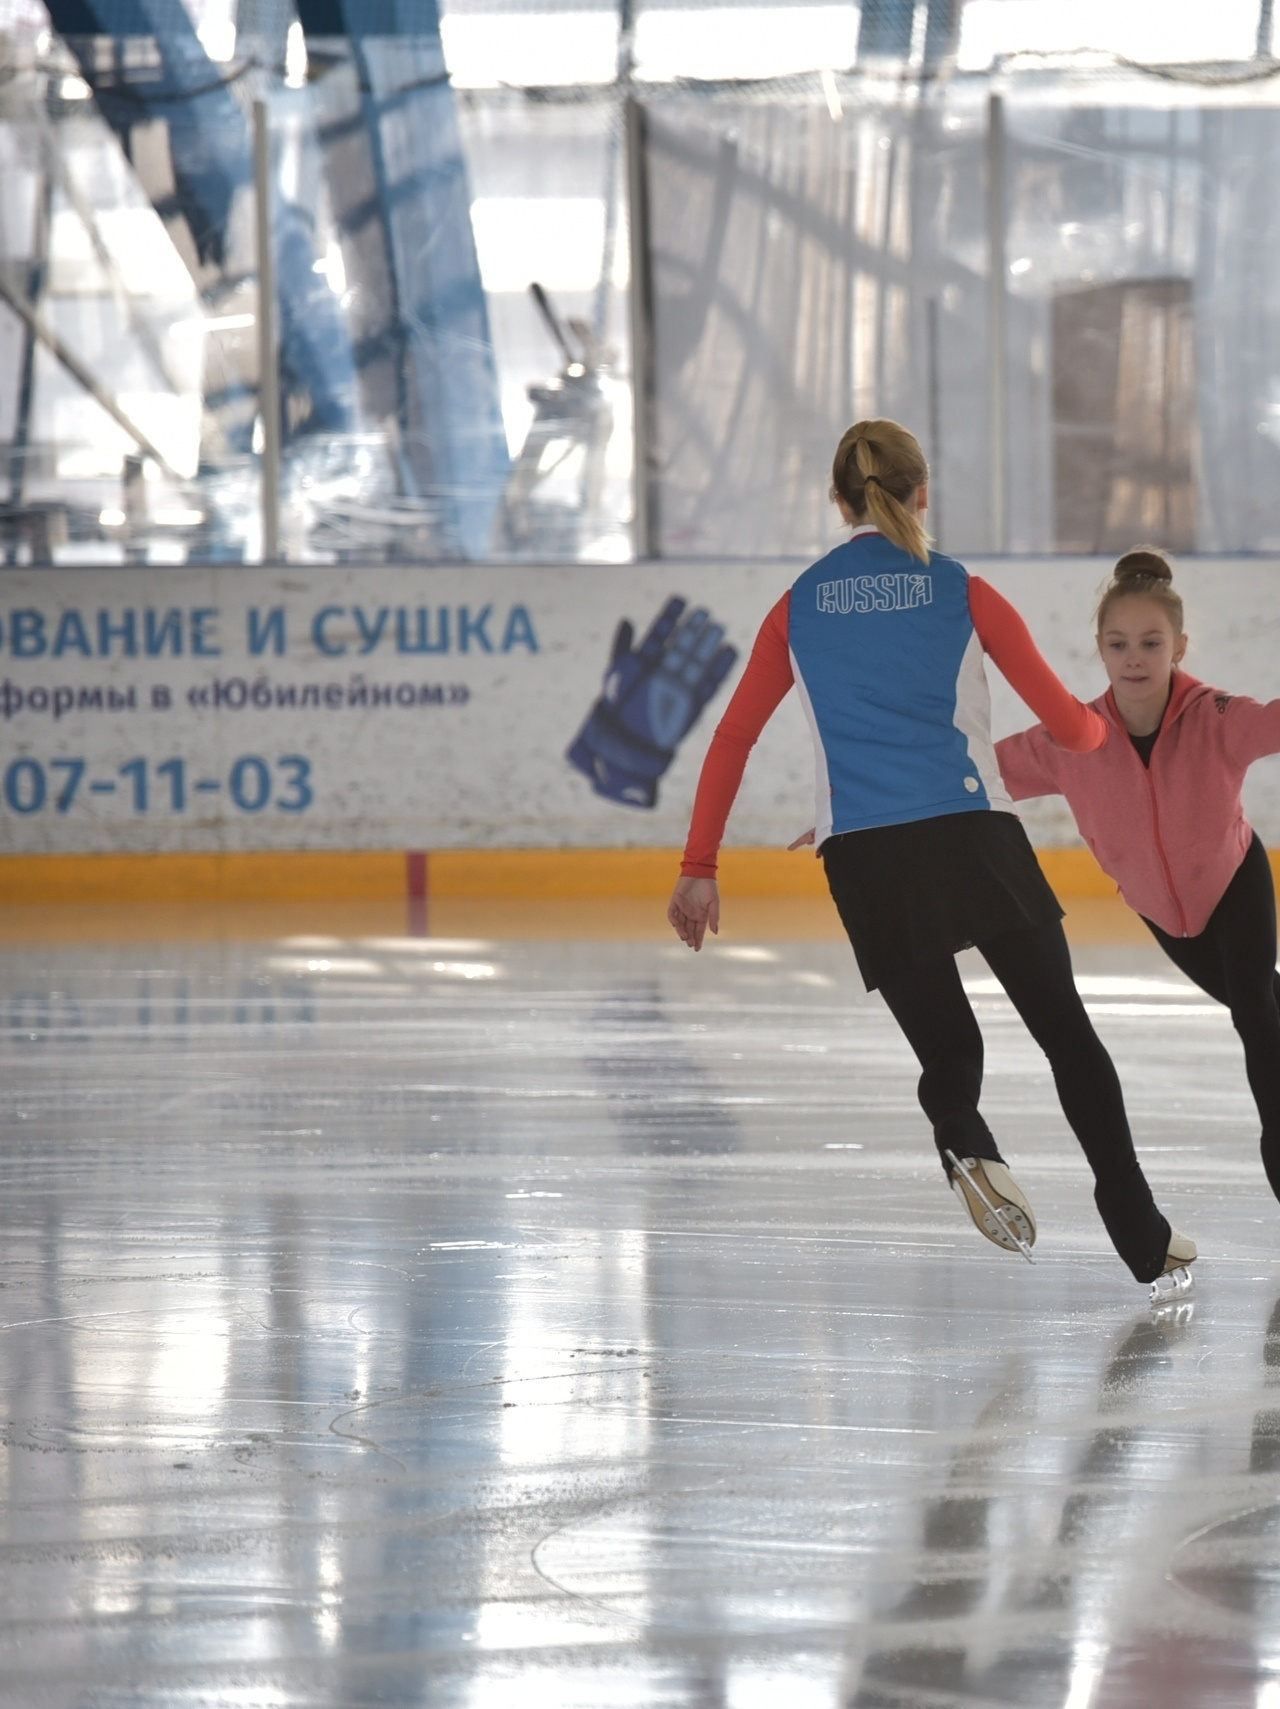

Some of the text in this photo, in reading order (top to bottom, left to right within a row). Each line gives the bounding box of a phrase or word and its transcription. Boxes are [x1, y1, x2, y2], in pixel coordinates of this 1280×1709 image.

[816, 573, 933, 614] RUSSIA
[0, 603, 540, 659] ВАНИЕ И СУШКА
[151, 684, 173, 710] в
[187, 672, 471, 711] «Юбилейном»
[4, 755, 314, 815] 07-11-03
